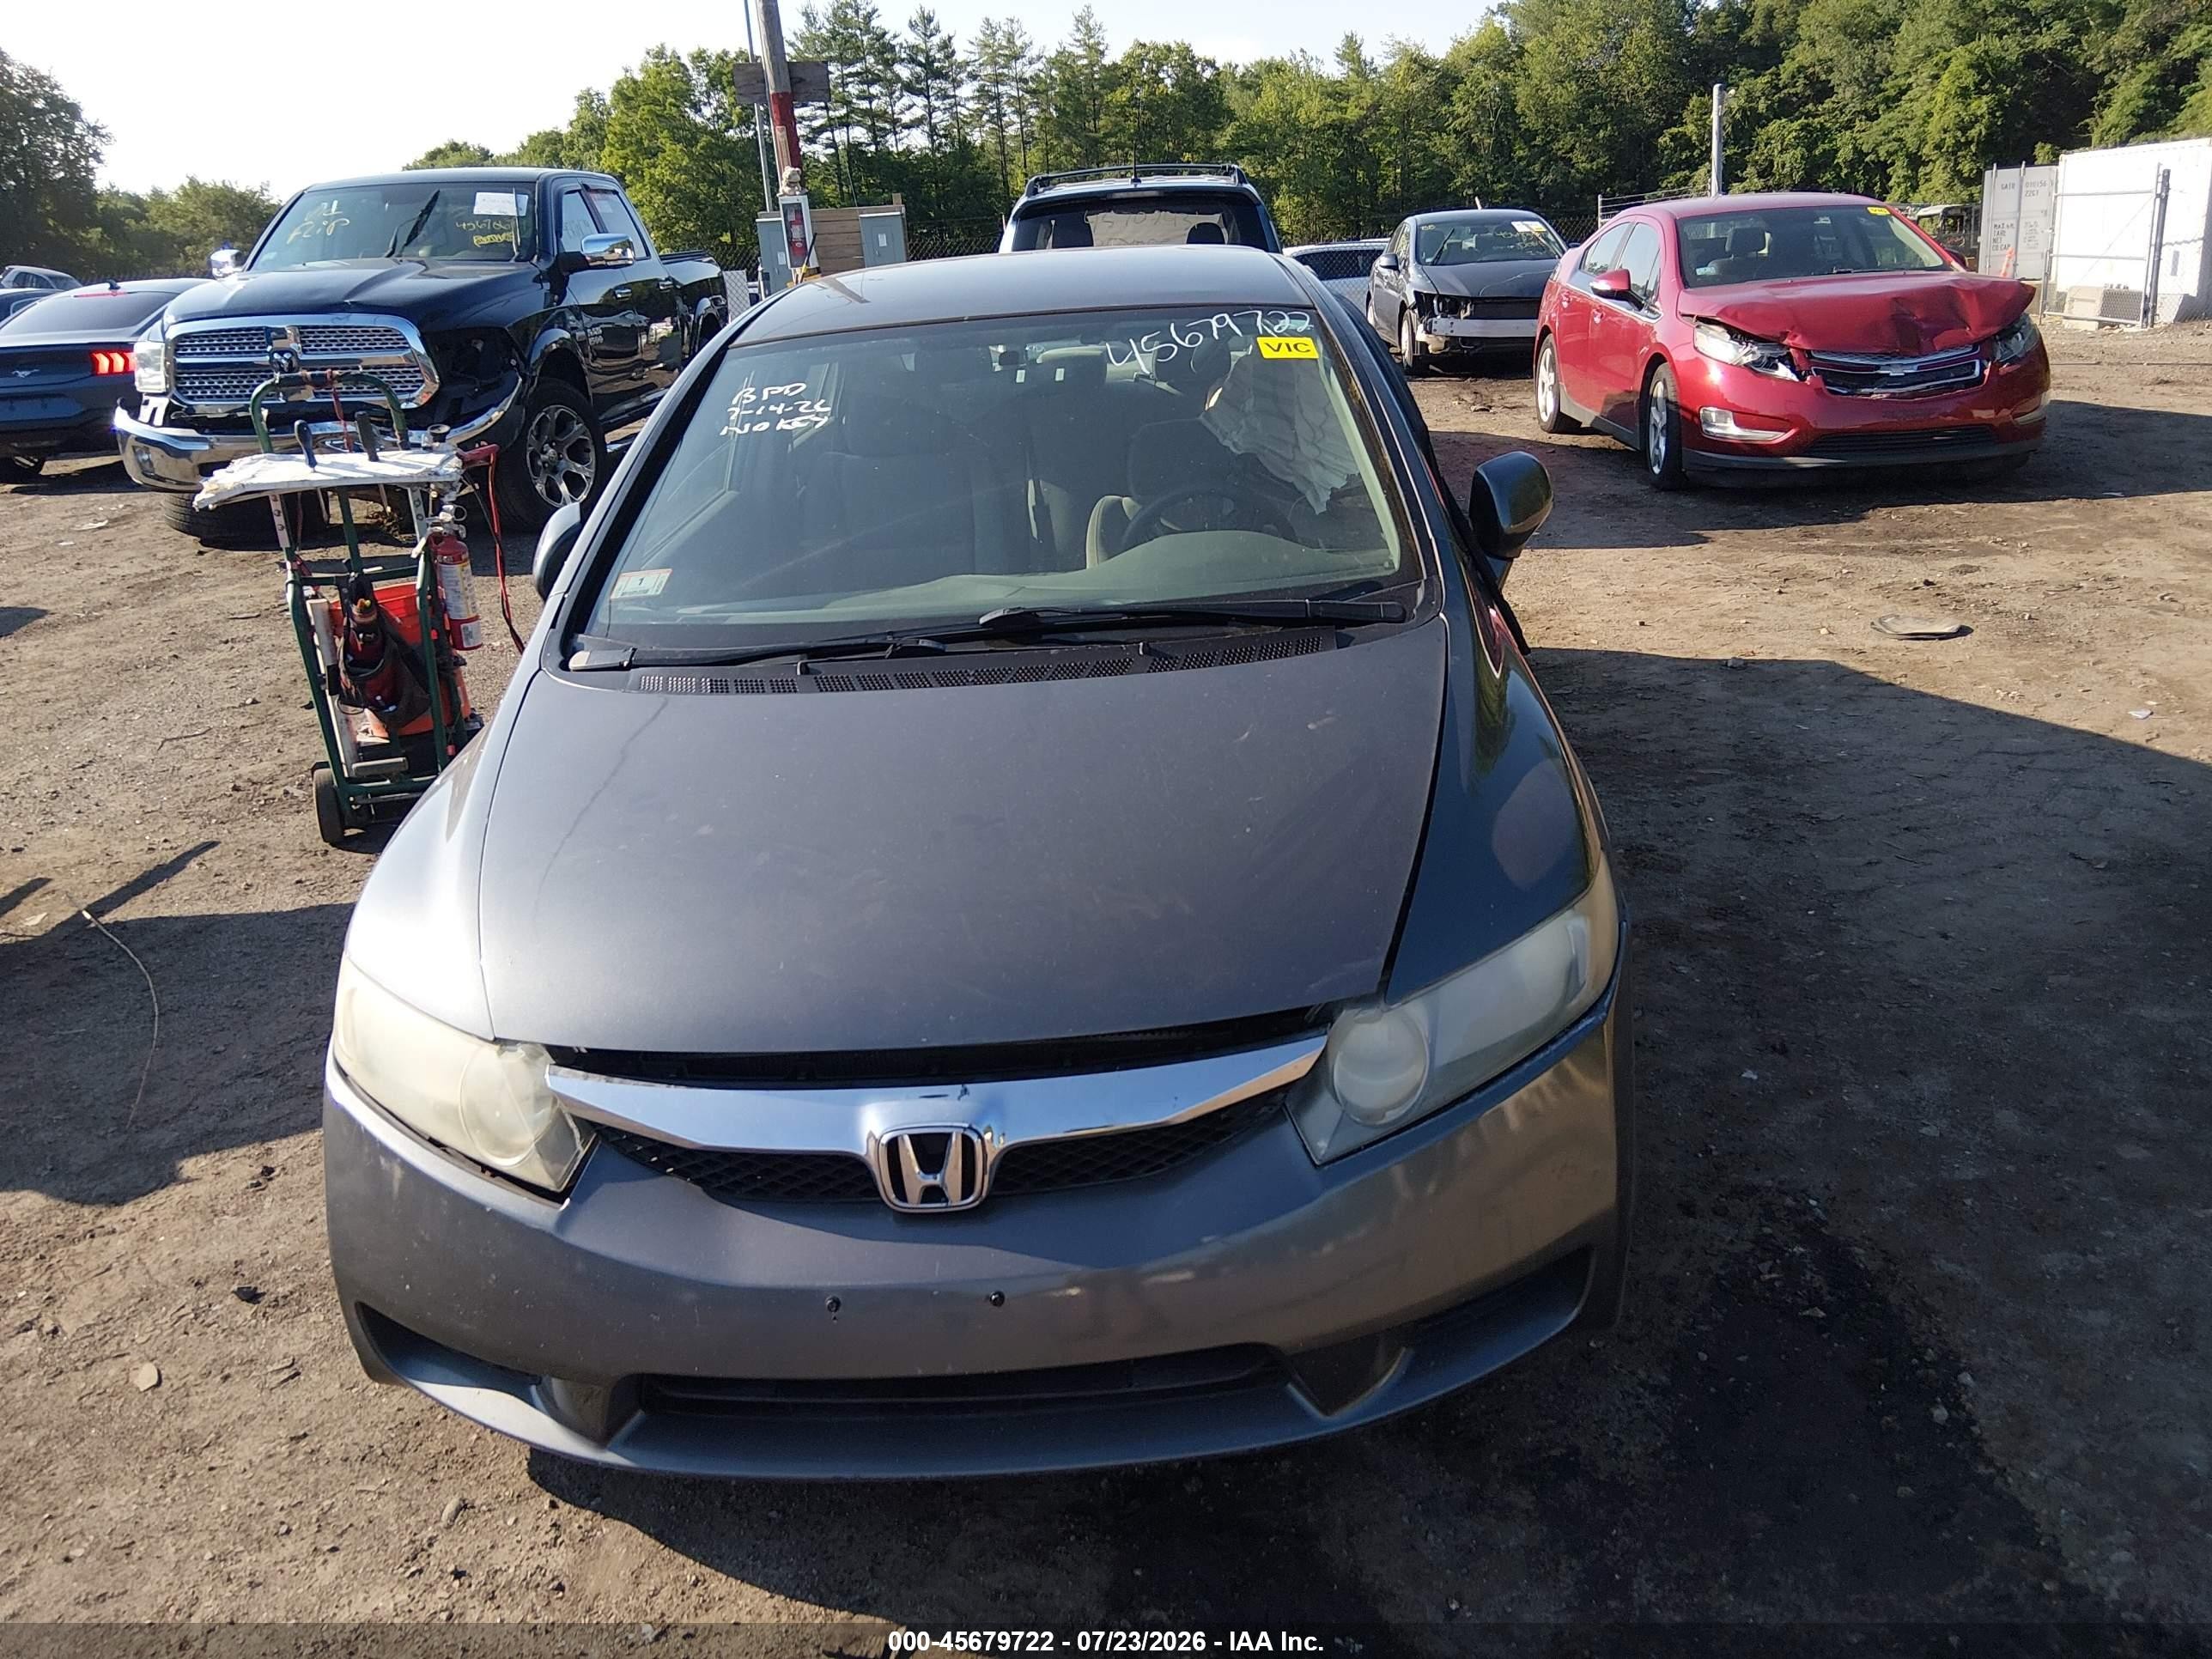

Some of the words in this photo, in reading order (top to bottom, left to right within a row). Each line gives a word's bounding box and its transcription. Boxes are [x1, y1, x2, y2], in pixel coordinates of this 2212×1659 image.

[1106, 310, 1315, 374] 45679722
[1263, 342, 1311, 353] VIC
[720, 422, 770, 435] NO
